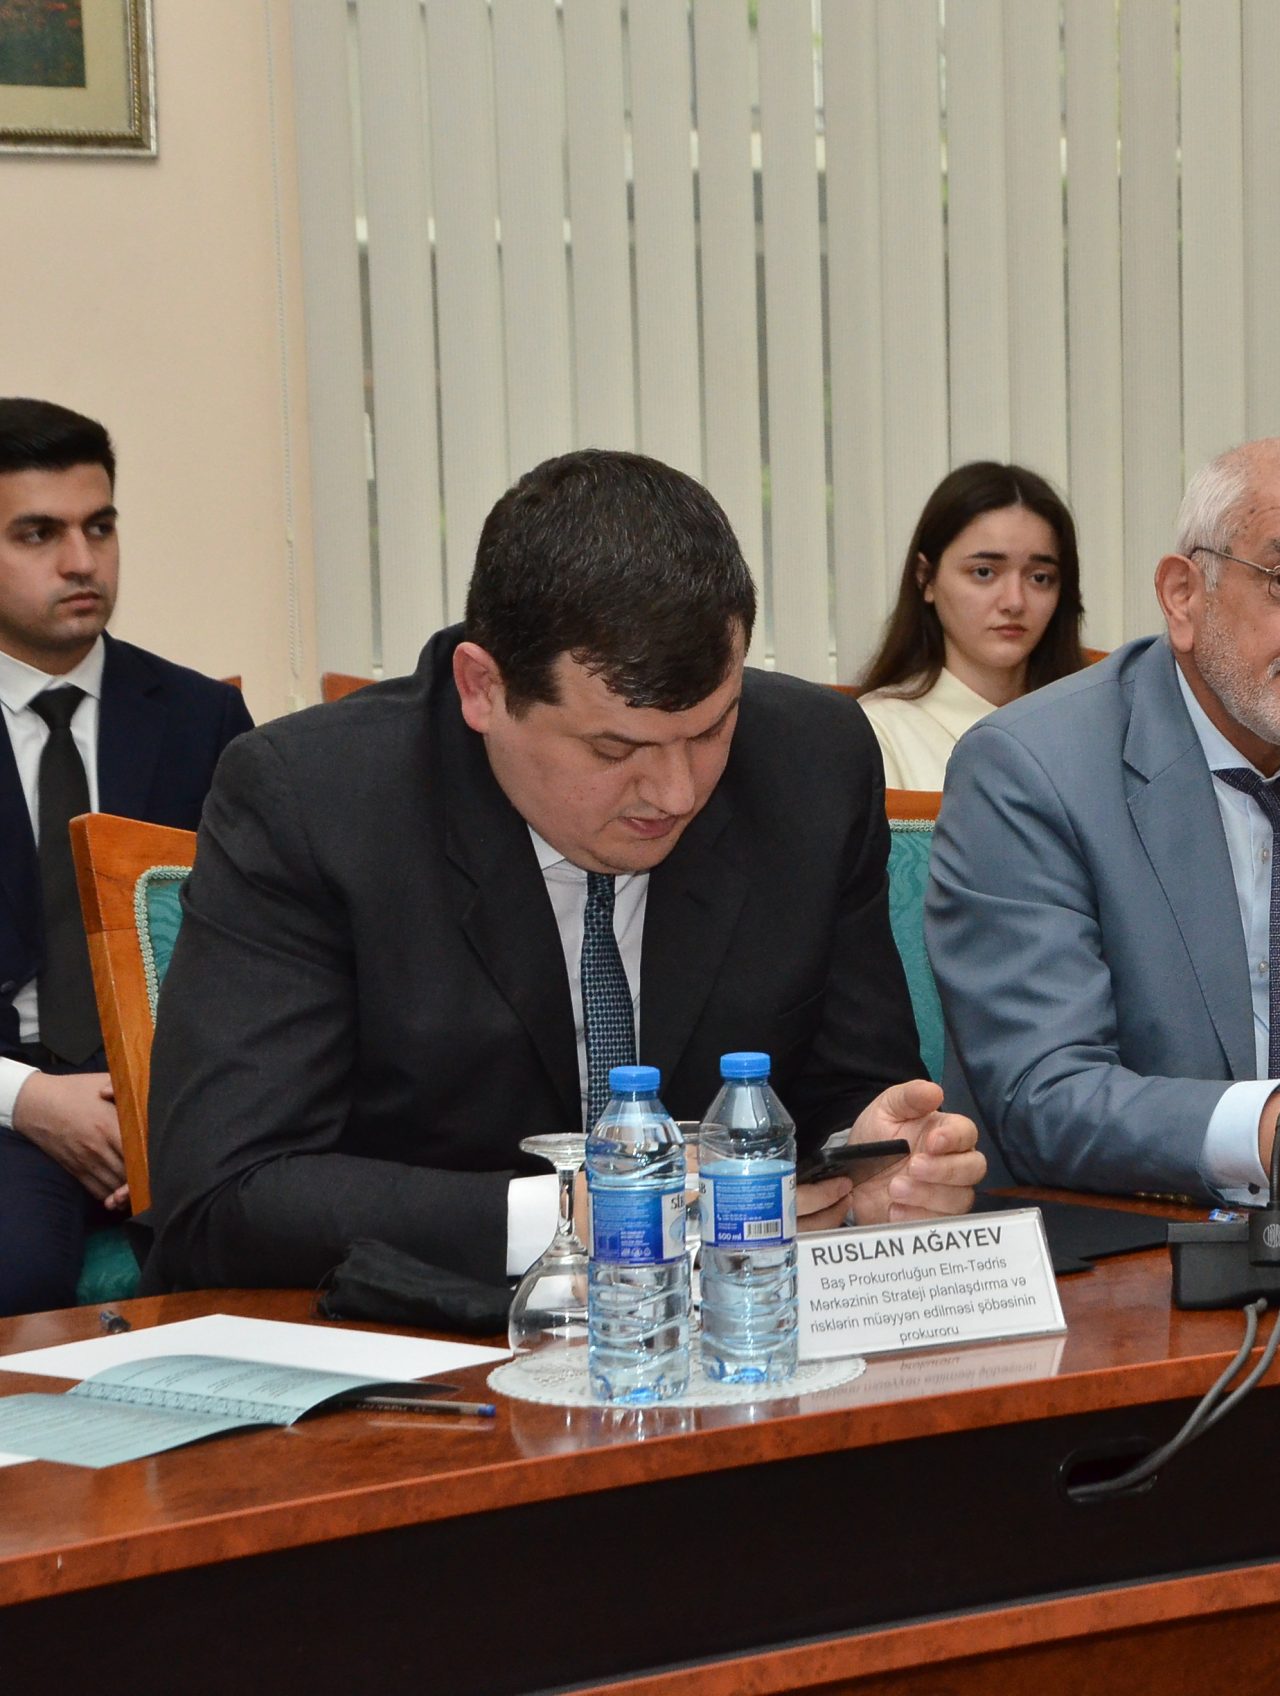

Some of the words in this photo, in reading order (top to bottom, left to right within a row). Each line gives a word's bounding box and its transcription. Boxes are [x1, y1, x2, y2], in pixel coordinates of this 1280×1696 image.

[811, 1237, 905, 1266] RUSLAN
[912, 1226, 1002, 1254] AĞAYEV
[820, 1276, 846, 1291] Baş
[848, 1266, 937, 1287] Prokurorluğun
[939, 1256, 1007, 1276] Elm-Tədris
[809, 1293, 879, 1312] Mərkəzinin
[882, 1286, 926, 1303] Strateji
[929, 1279, 1008, 1300] planlaşdırma
[1011, 1276, 1027, 1287] və
[810, 1316, 860, 1334] risklərin
[863, 1311, 921, 1327] müəyyən
[923, 1301, 975, 1319] edilməsi
[978, 1294, 1036, 1315] şöbəsinin
[900, 1326, 959, 1345] prokuroru
